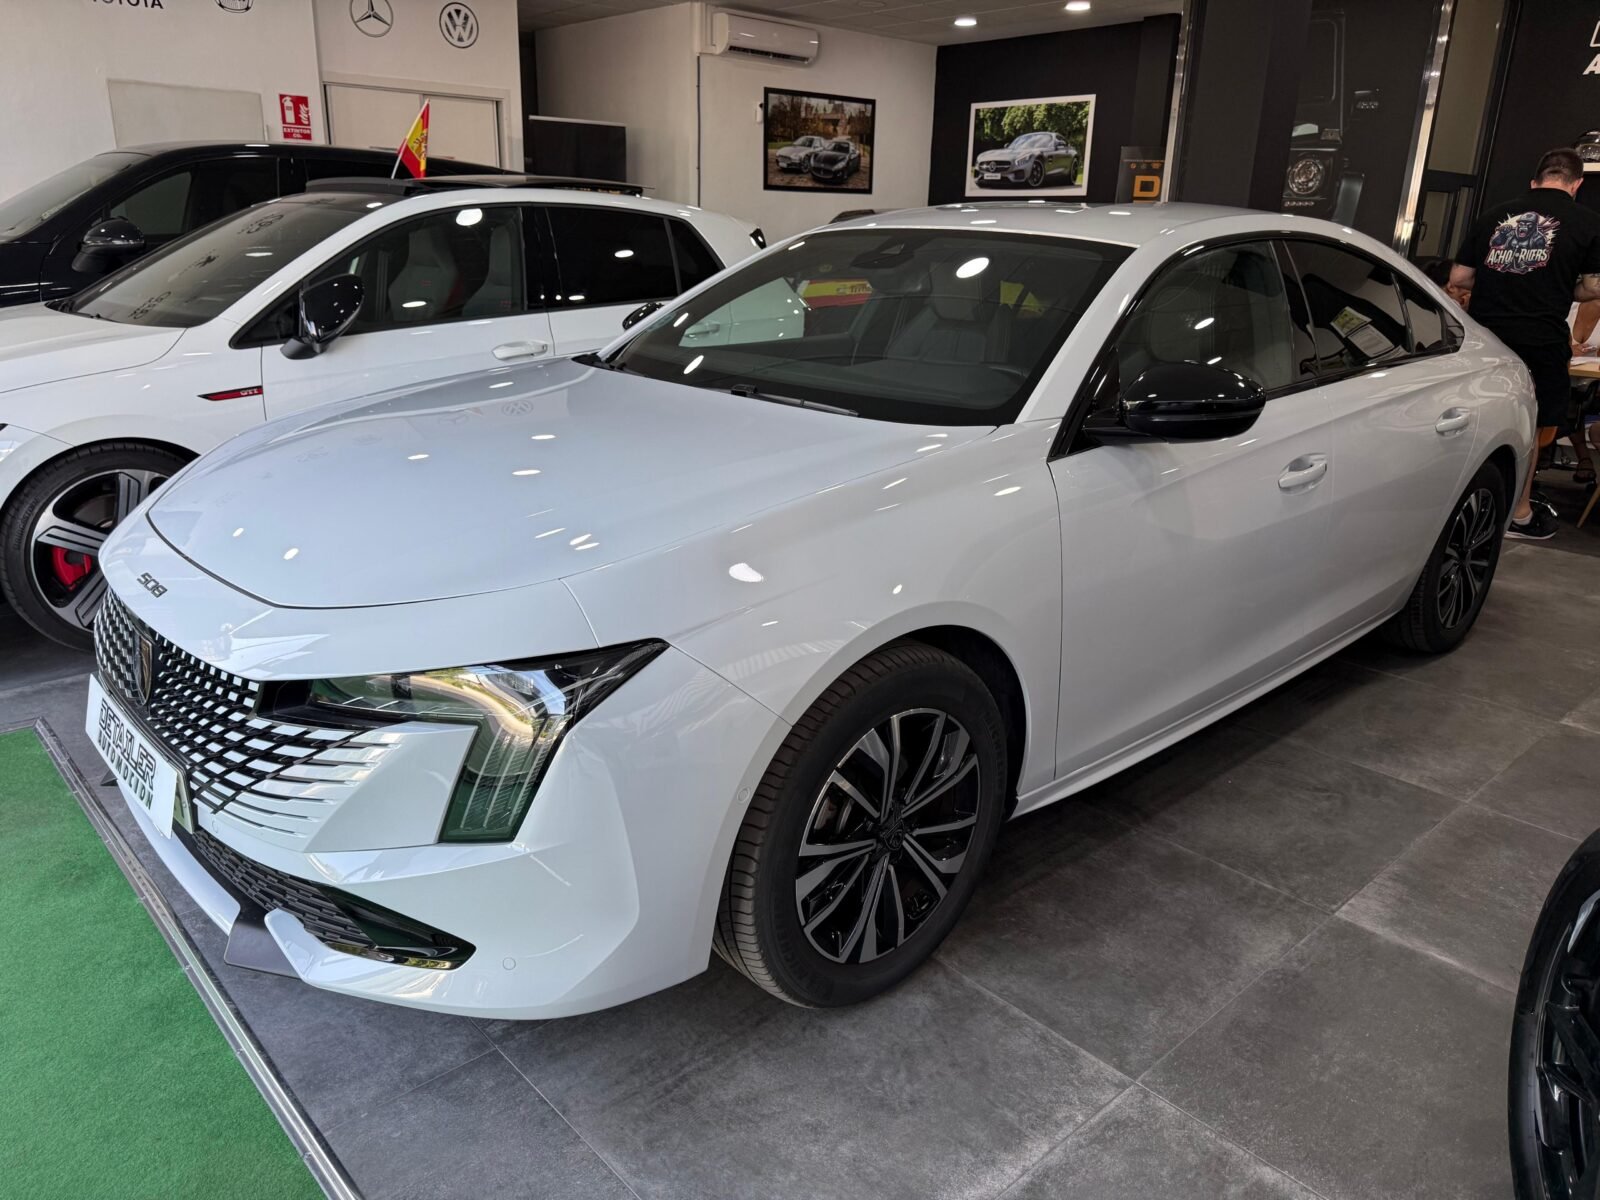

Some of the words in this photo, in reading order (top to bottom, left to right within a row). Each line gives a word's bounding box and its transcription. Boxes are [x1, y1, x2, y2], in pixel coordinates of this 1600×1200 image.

[240, 387, 258, 396] GTI
[136, 572, 168, 598] 508
[98, 730, 154, 810] AUTOMOCION
[99, 698, 157, 790] DETAILER
